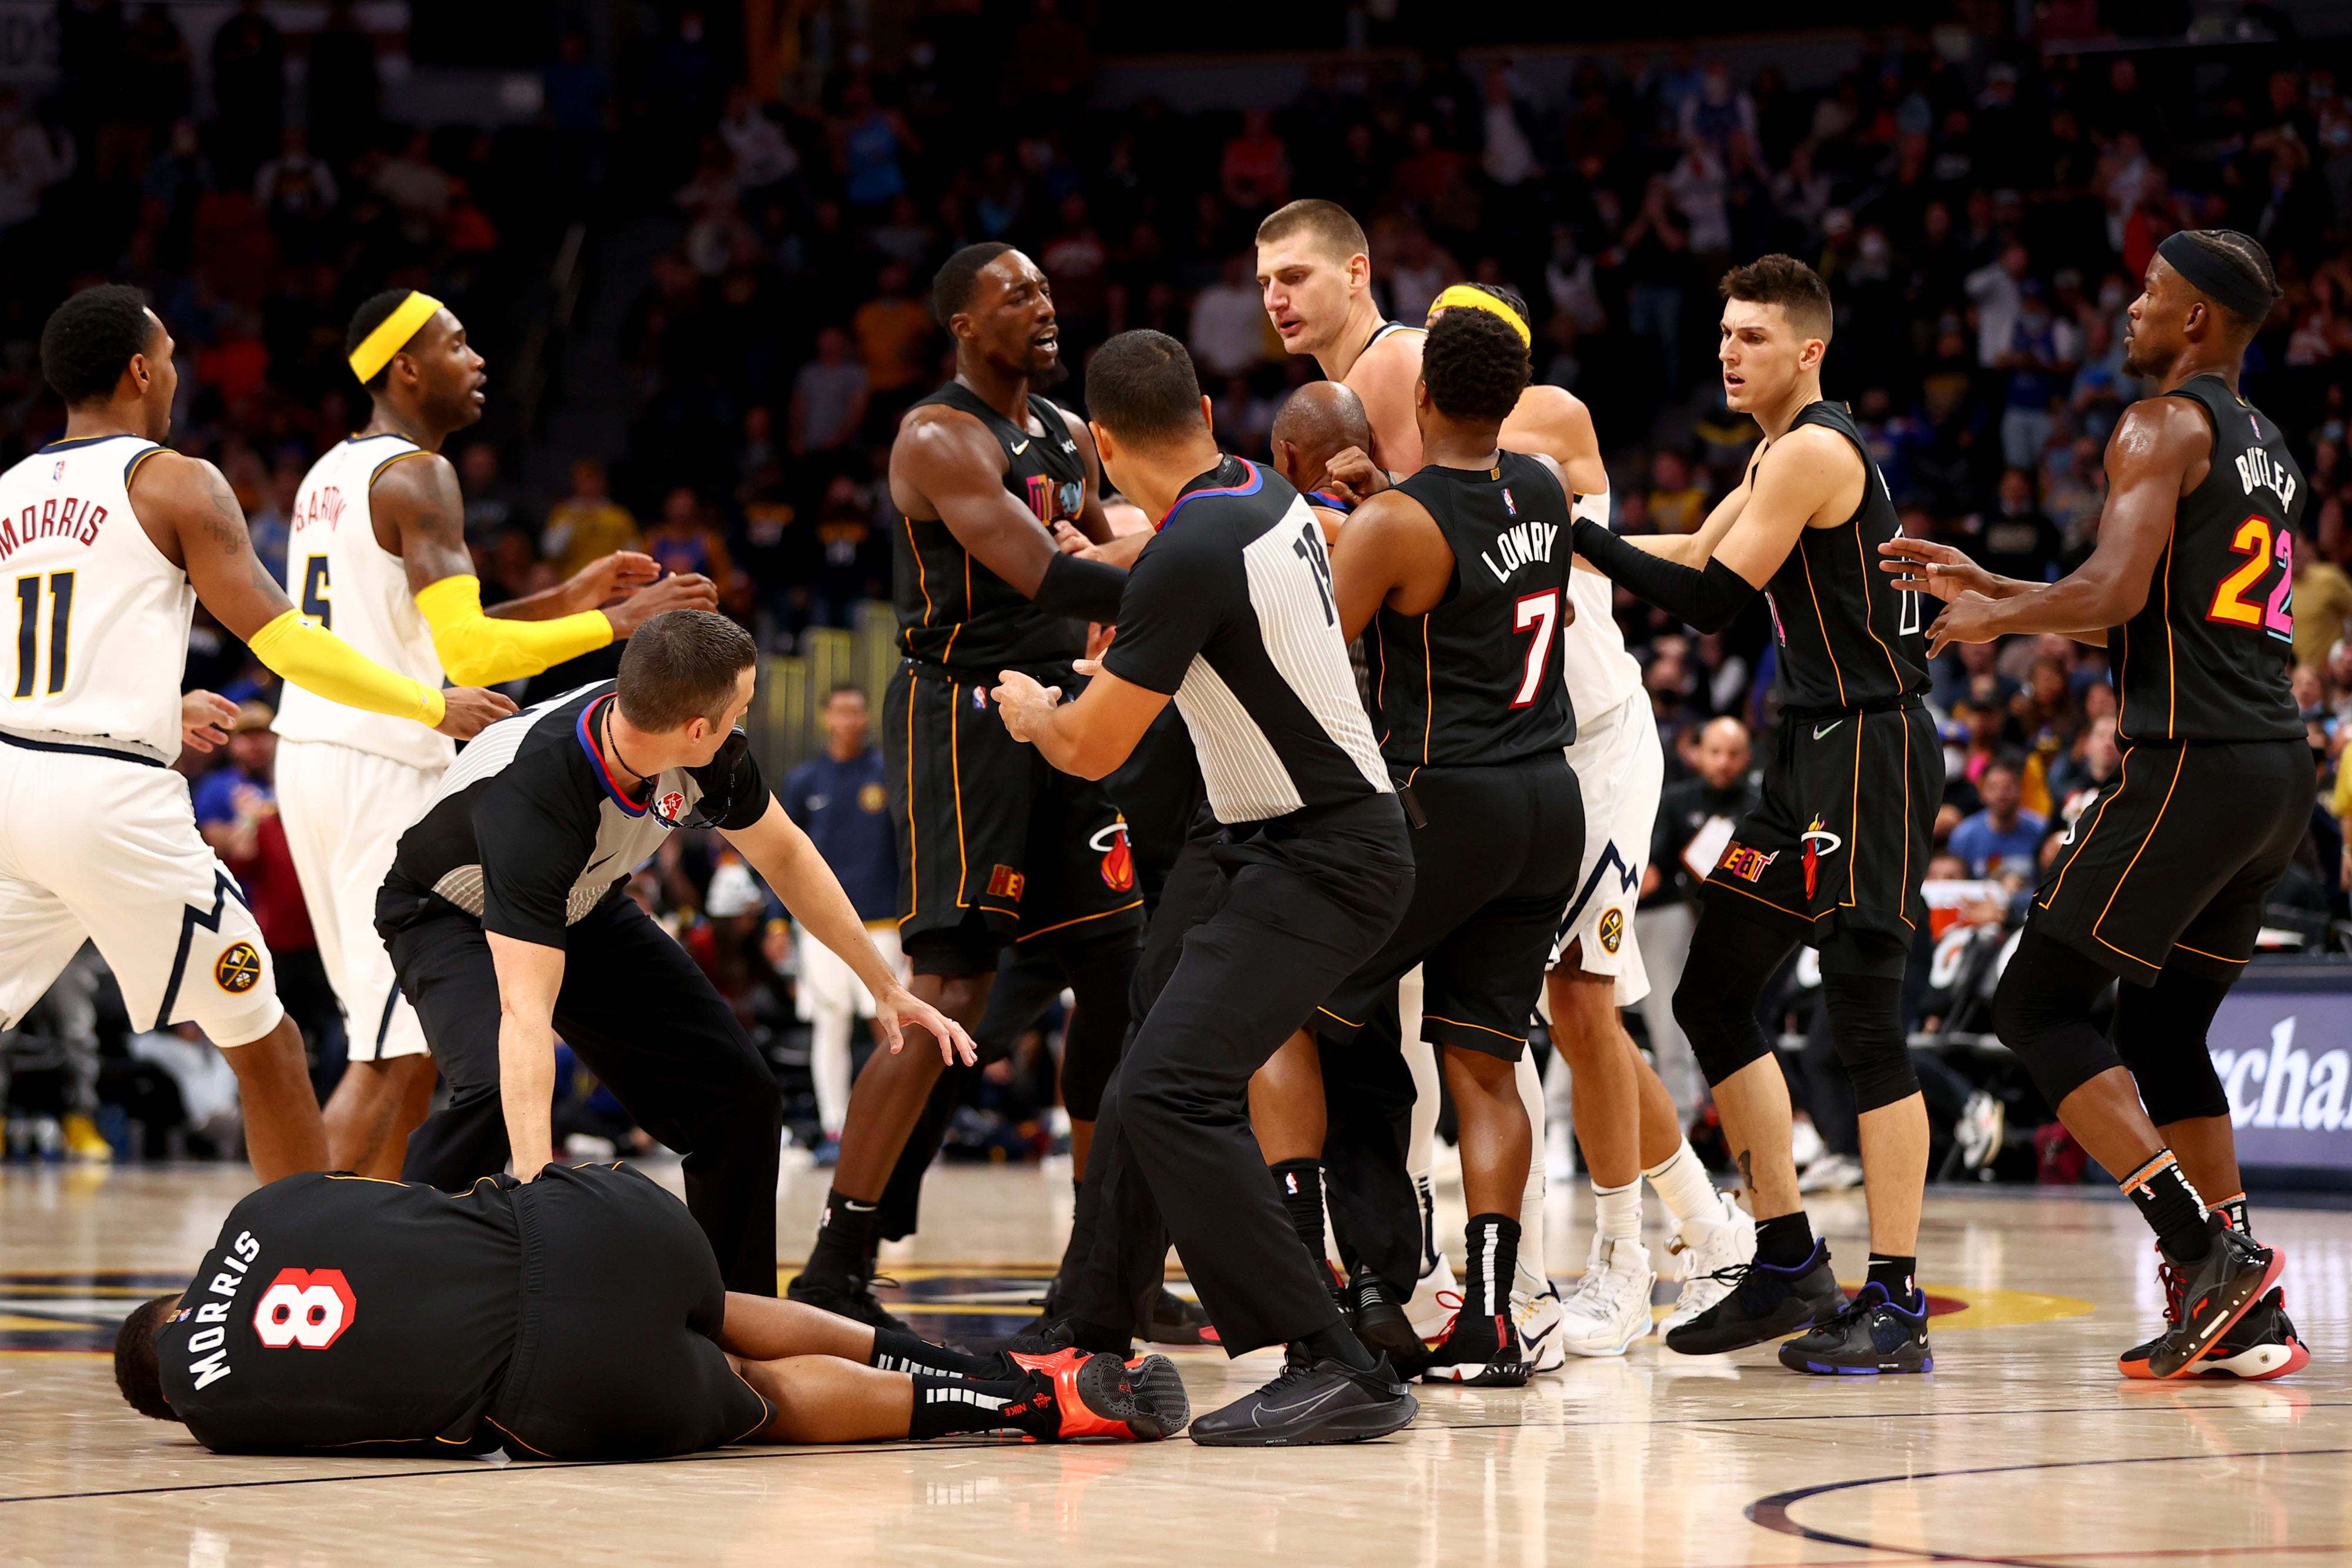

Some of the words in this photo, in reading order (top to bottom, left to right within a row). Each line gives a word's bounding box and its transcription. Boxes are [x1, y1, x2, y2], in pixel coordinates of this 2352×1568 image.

[0, 497, 108, 561] MORRIS
[2235, 446, 2296, 514] BUTLER
[1482, 521, 1558, 583] LOWRY
[2206, 513, 2293, 644] 22
[11, 569, 77, 700] 11
[1509, 587, 1559, 710] 7
[2210, 1015, 2352, 1132] rcha
[188, 1230, 260, 1391] MORRIS
[252, 1268, 357, 1350] 8
[1004, 1402, 1028, 1417] NIKE
